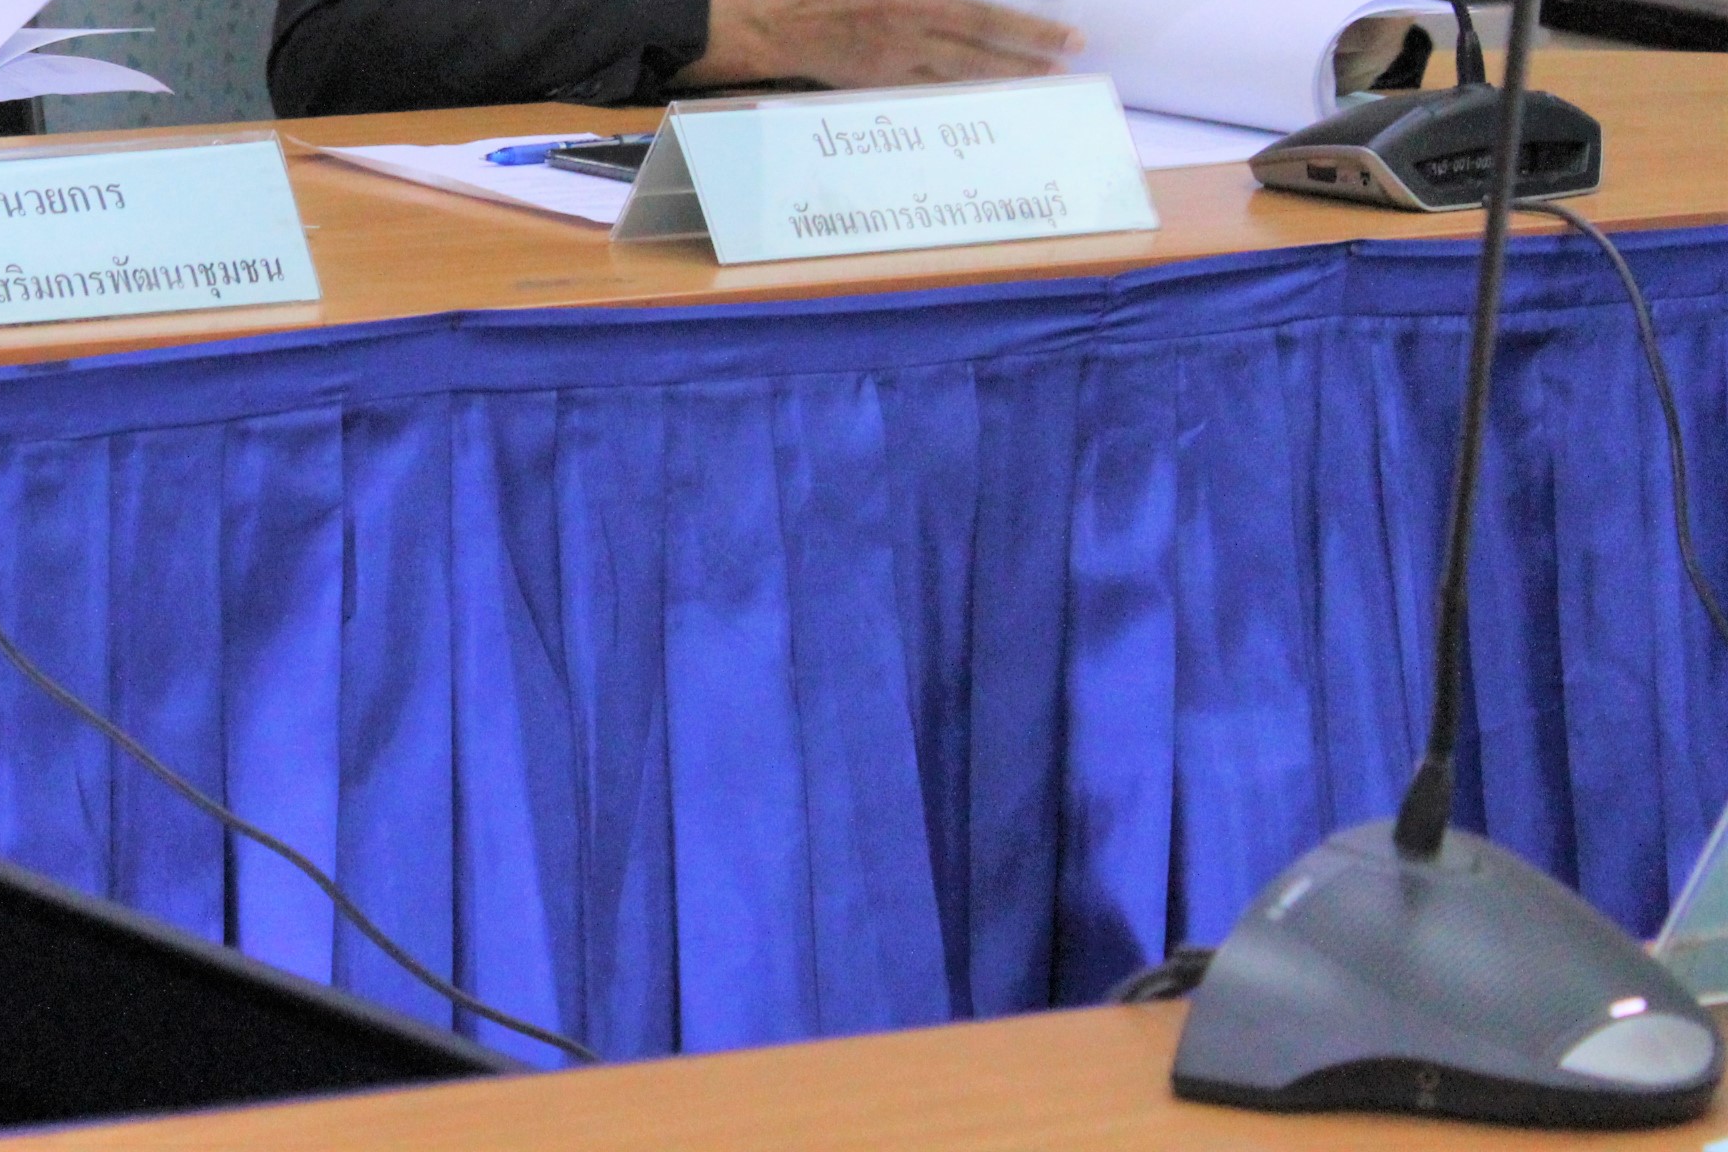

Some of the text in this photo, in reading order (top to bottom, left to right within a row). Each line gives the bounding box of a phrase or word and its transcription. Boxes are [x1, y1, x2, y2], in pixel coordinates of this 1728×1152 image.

[813, 114, 996, 160] ประเมิน อุมา
[789, 180, 1068, 238] พัฒนาการจังหวัดชลบุรี
